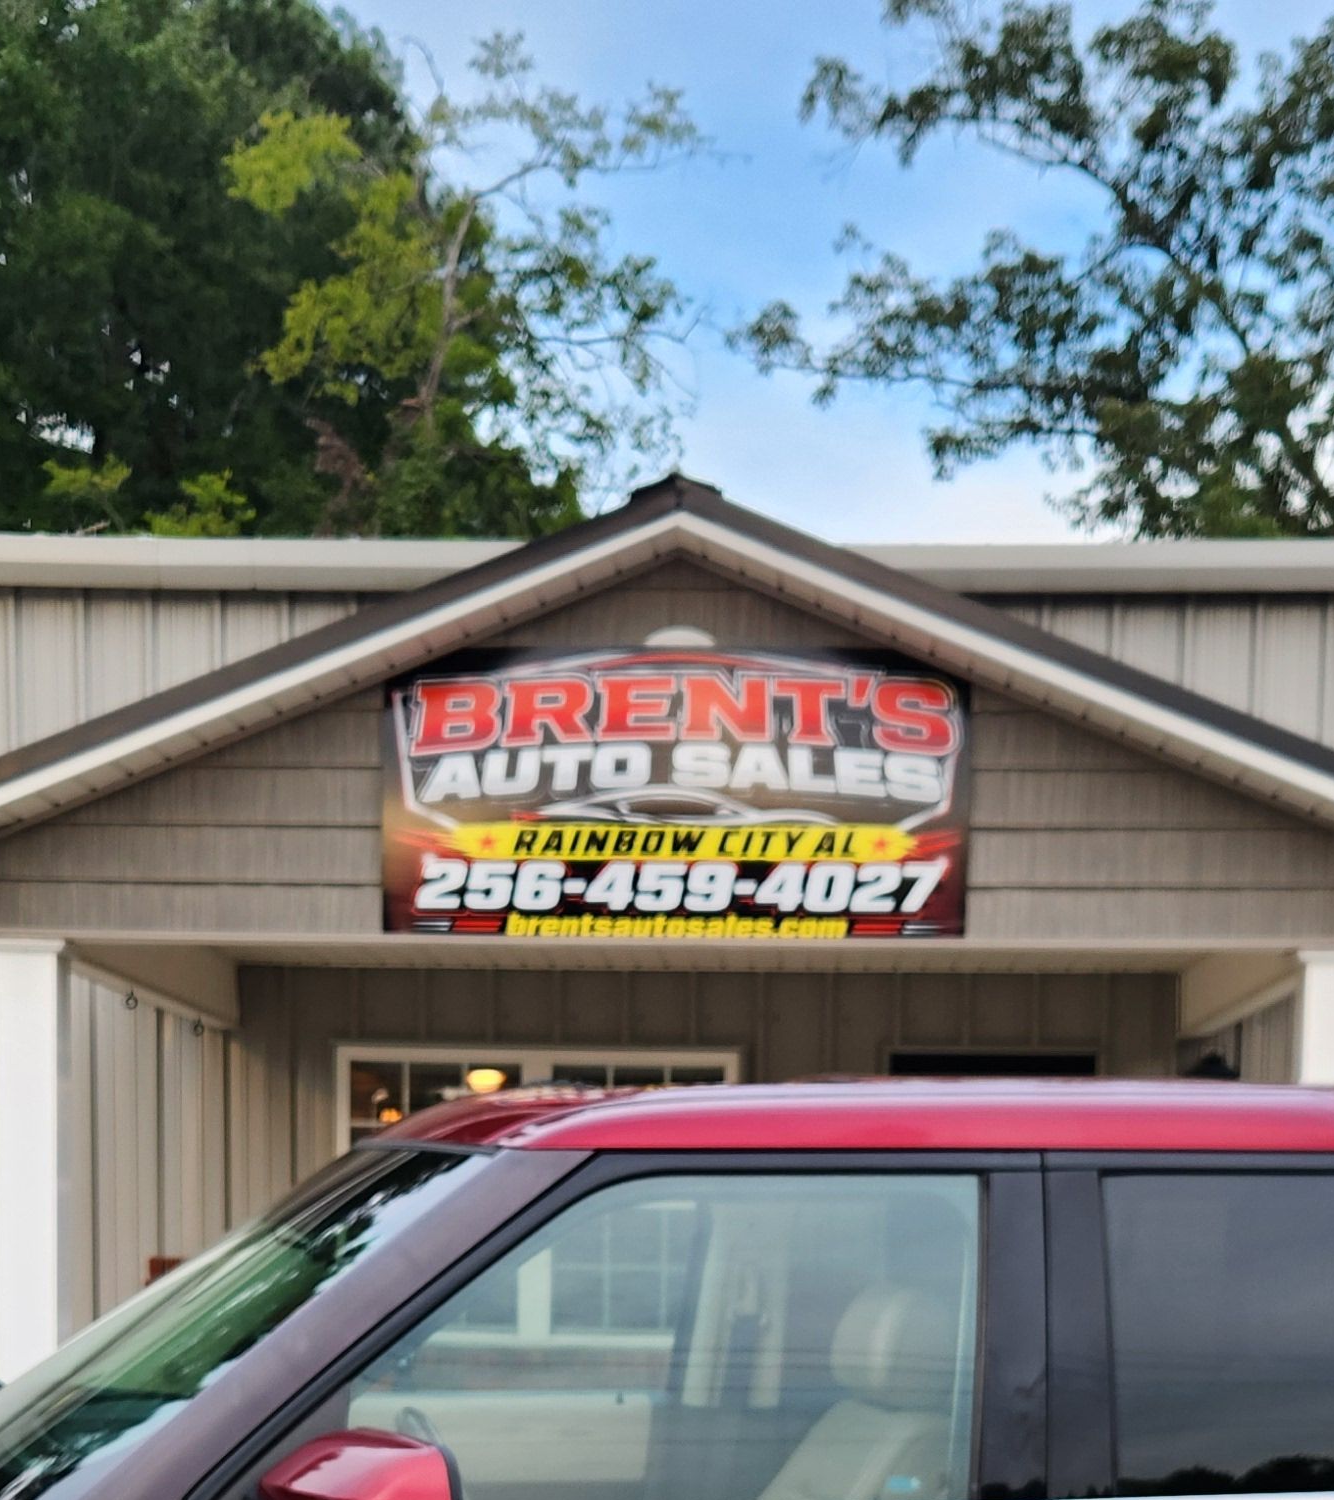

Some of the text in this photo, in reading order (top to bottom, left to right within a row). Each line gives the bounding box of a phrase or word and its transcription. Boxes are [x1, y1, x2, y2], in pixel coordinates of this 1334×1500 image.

[411, 670, 959, 755] BRENT'S
[419, 741, 945, 801] AUTO SALES
[512, 829, 857, 857] RAINBOW CITY AL
[414, 859, 947, 914] 256-459-4027
[505, 912, 850, 939] brentsautosales.com
